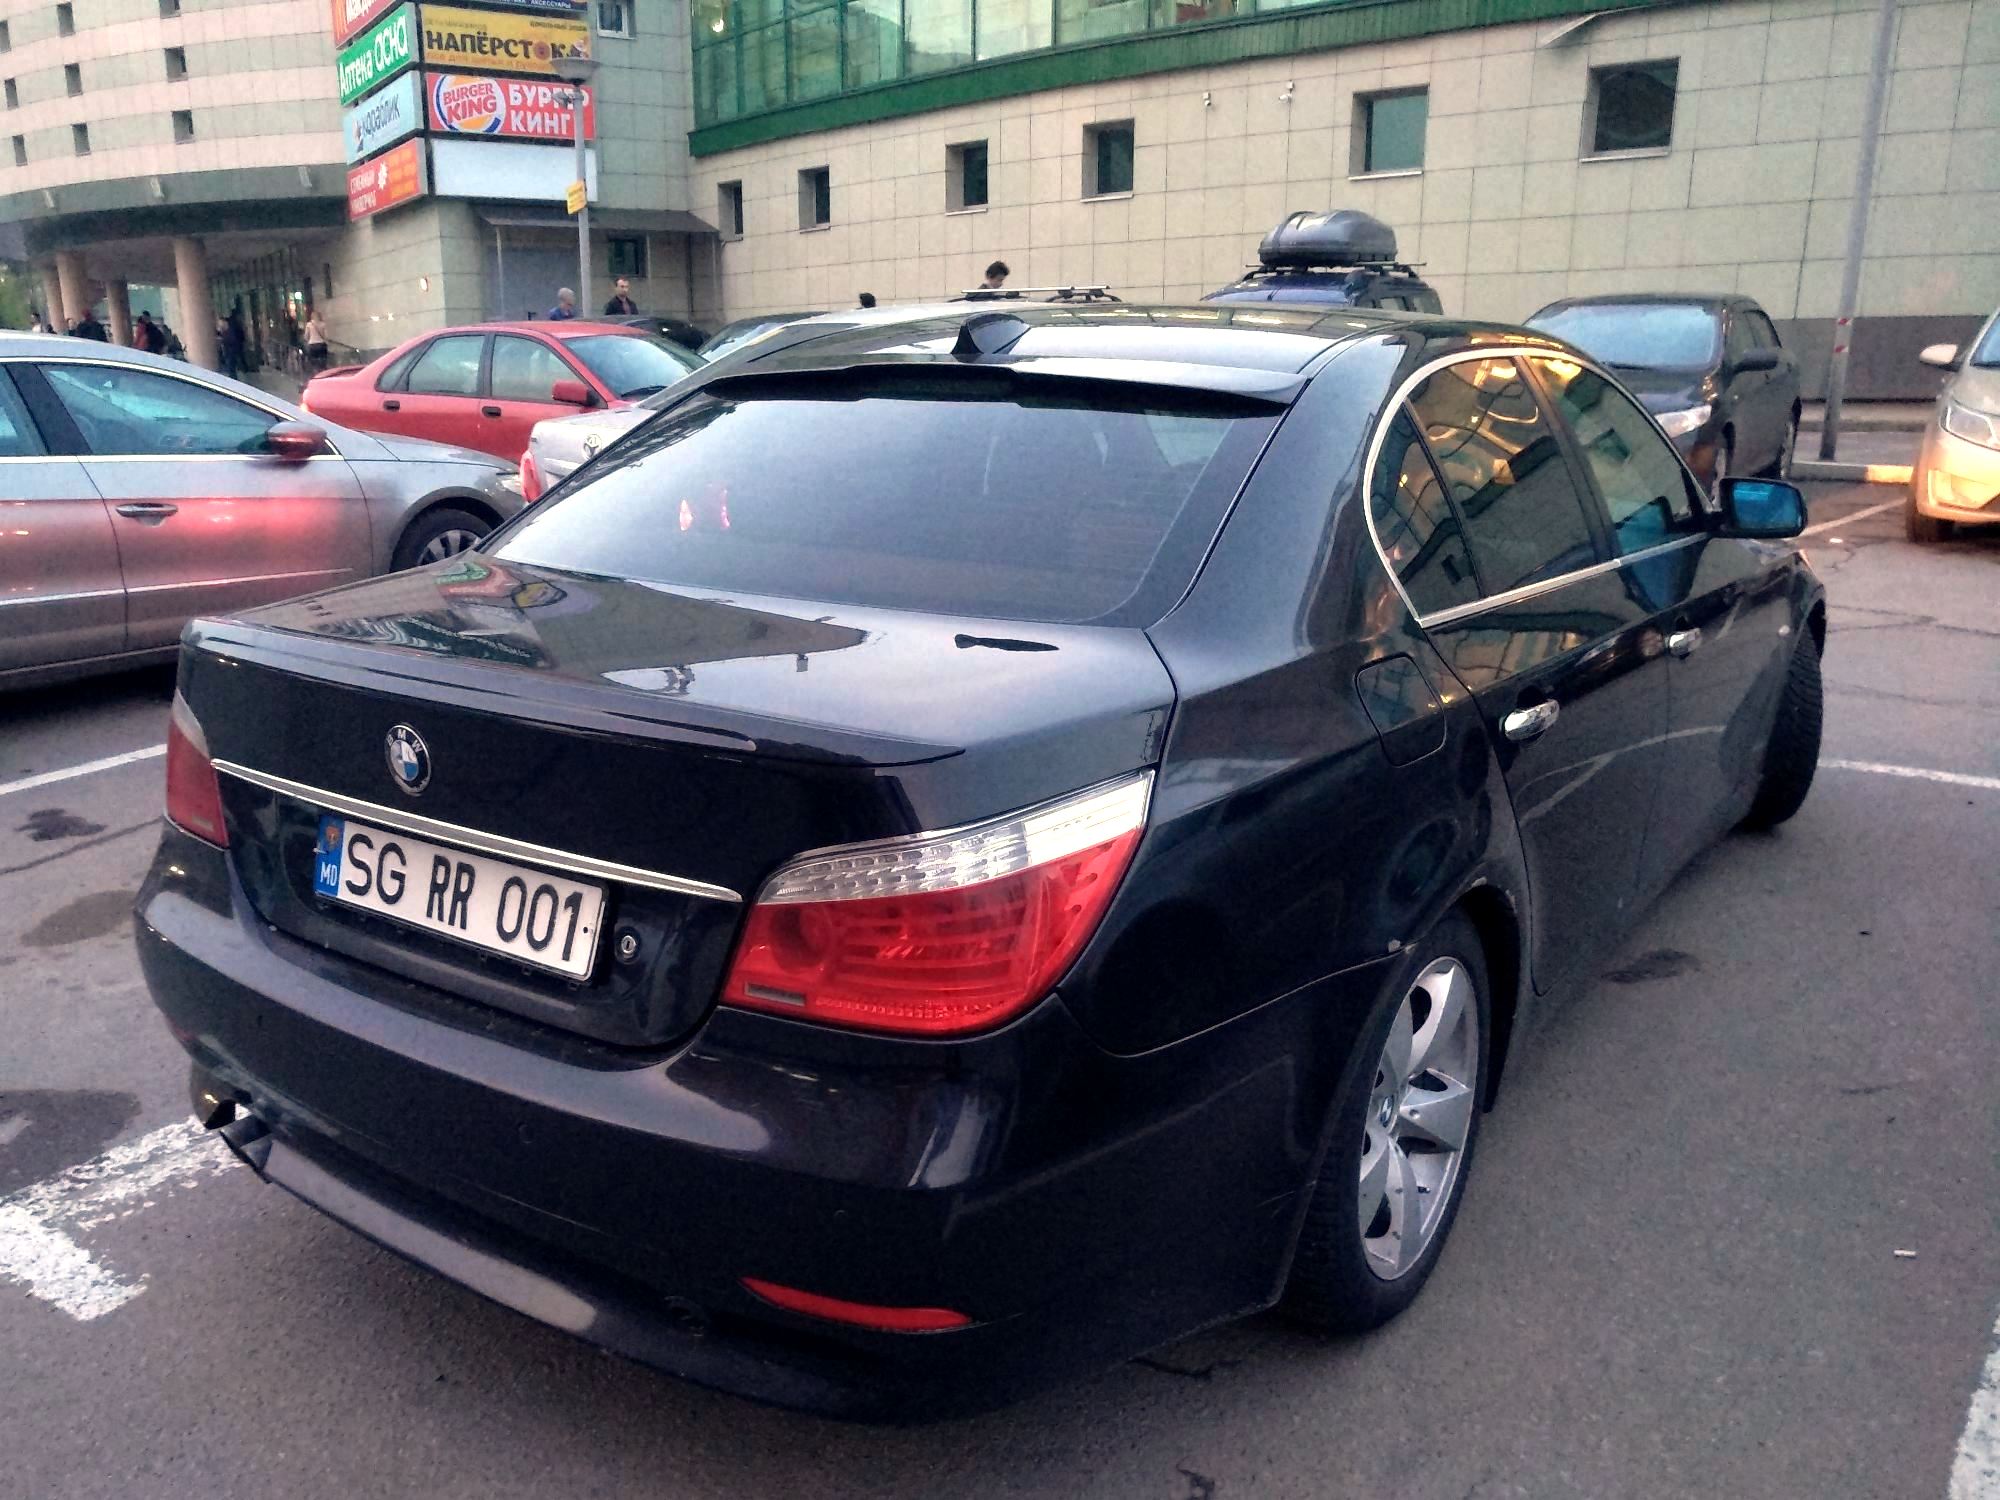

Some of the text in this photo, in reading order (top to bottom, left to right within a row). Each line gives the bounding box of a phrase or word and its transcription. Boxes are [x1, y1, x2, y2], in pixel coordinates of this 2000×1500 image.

[339, 49, 373, 98] Аптека
[443, 82, 494, 105] BURGER
[446, 95, 497, 124] KING
[510, 110, 571, 135] КИНГ
[387, 728, 423, 752] BMW
[320, 860, 338, 886] MD
[345, 833, 584, 962] SG RR 001
